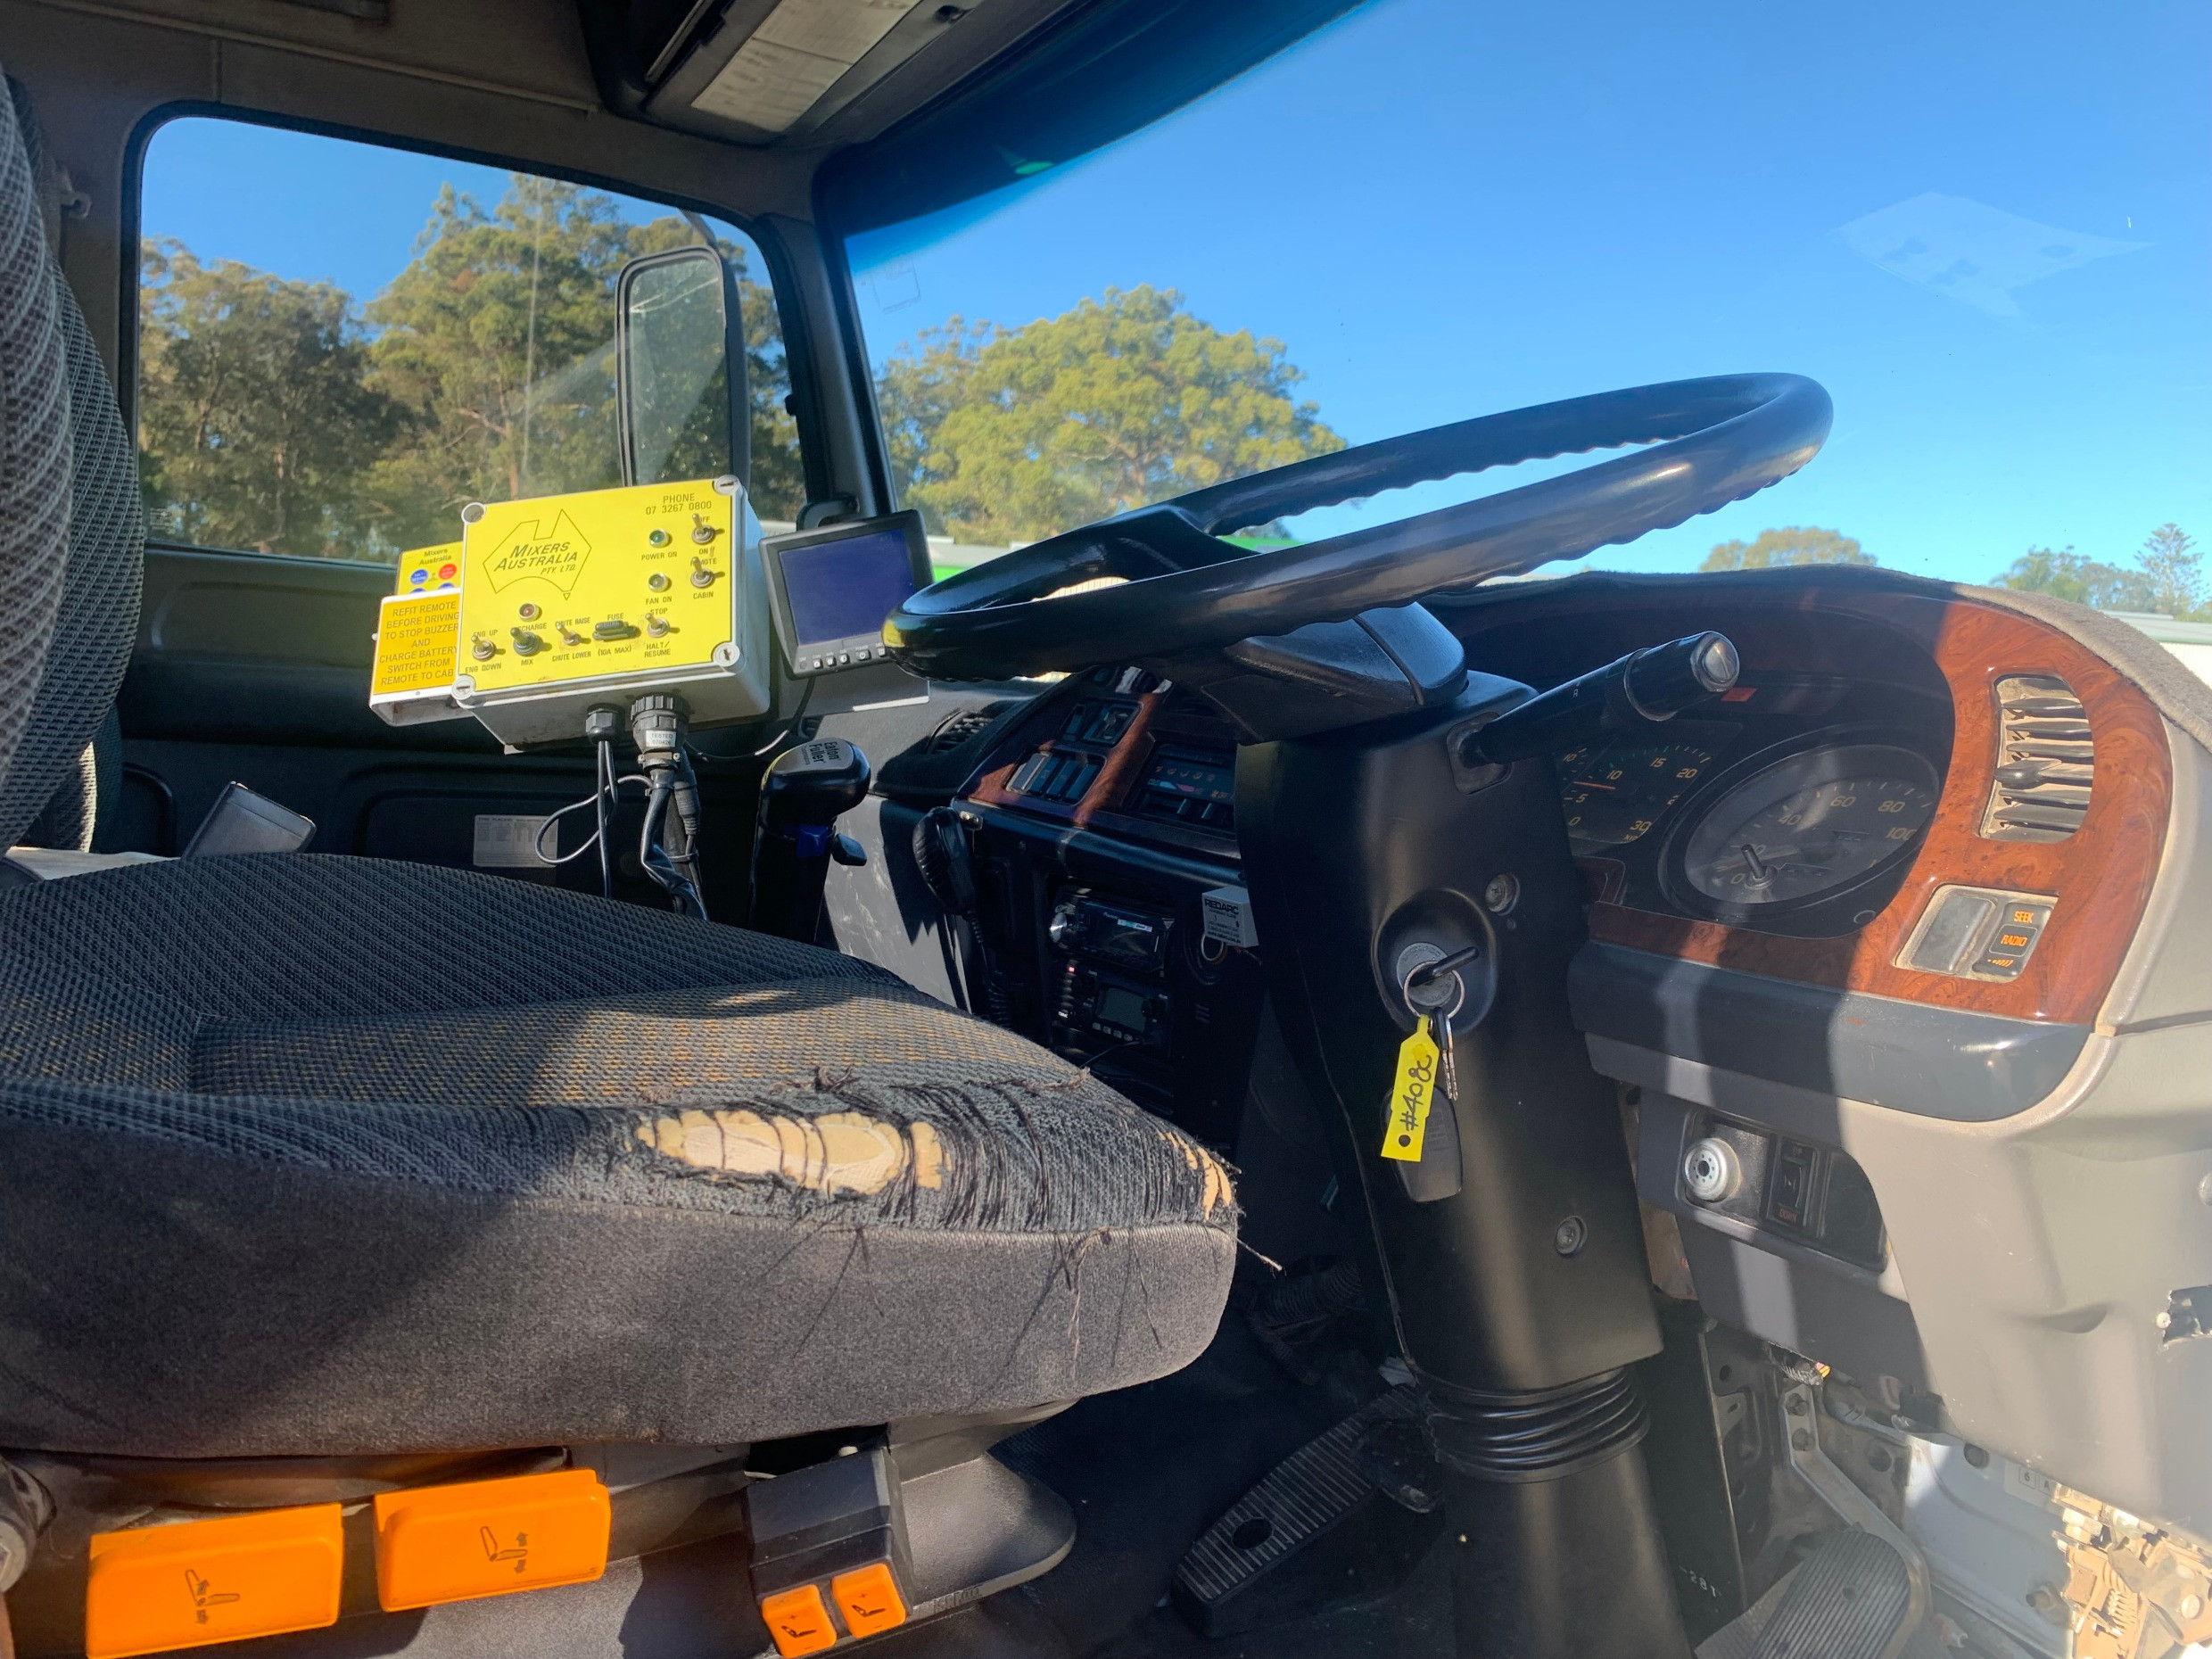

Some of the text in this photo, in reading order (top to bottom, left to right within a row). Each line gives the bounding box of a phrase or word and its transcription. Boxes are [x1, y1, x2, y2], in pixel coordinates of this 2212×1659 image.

[663, 493, 695, 504] PHONE
[645, 500, 712, 515] 07 3267 0800
[424, 549, 448, 557] Mixers
[641, 553, 664, 561] POWER
[418, 555, 451, 566] Australia
[693, 591, 714, 600] CABIN
[392, 600, 457, 617] REFIT REMOTE
[649, 607, 668, 615] STOP
[386, 611, 459, 629] BEFORE DRIVING
[575, 617, 590, 625] RAISE
[607, 613, 624, 621] FUSE
[385, 623, 458, 640] TO STOP BUZZER
[411, 638, 431, 648] AND
[646, 641, 670, 650] HALT/
[614, 645, 631, 655] MAX)
[644, 648, 671, 658] RESUME
[379, 649, 417, 664] CHARGE
[521, 658, 533, 666] MIX
[552, 651, 591, 662] CHUTE LOWER
[387, 657, 450, 673] SWITCH FROM
[465, 663, 501, 673] ENG DOWN
[381, 667, 454, 686] REMOTE TO CAB
[1563, 754, 1578, 763] 10
[1650, 757, 1667, 768] 15
[1606, 770, 1623, 780] 10
[1676, 768, 1698, 779] 20
[1575, 793, 1589, 804] 5
[1829, 796, 1857, 807] 60
[1878, 800, 1906, 813] 80
[1569, 816, 1581, 827] 0
[1778, 813, 1803, 826] 40
[1630, 820, 1652, 831] 30
[1730, 873, 1746, 884] 0
[1204, 898, 1239, 915] REDARC
[2013, 911, 2035, 924] SEEK
[2000, 934, 2027, 947] RADIO
[2024, 1472, 2030, 1482] 6
